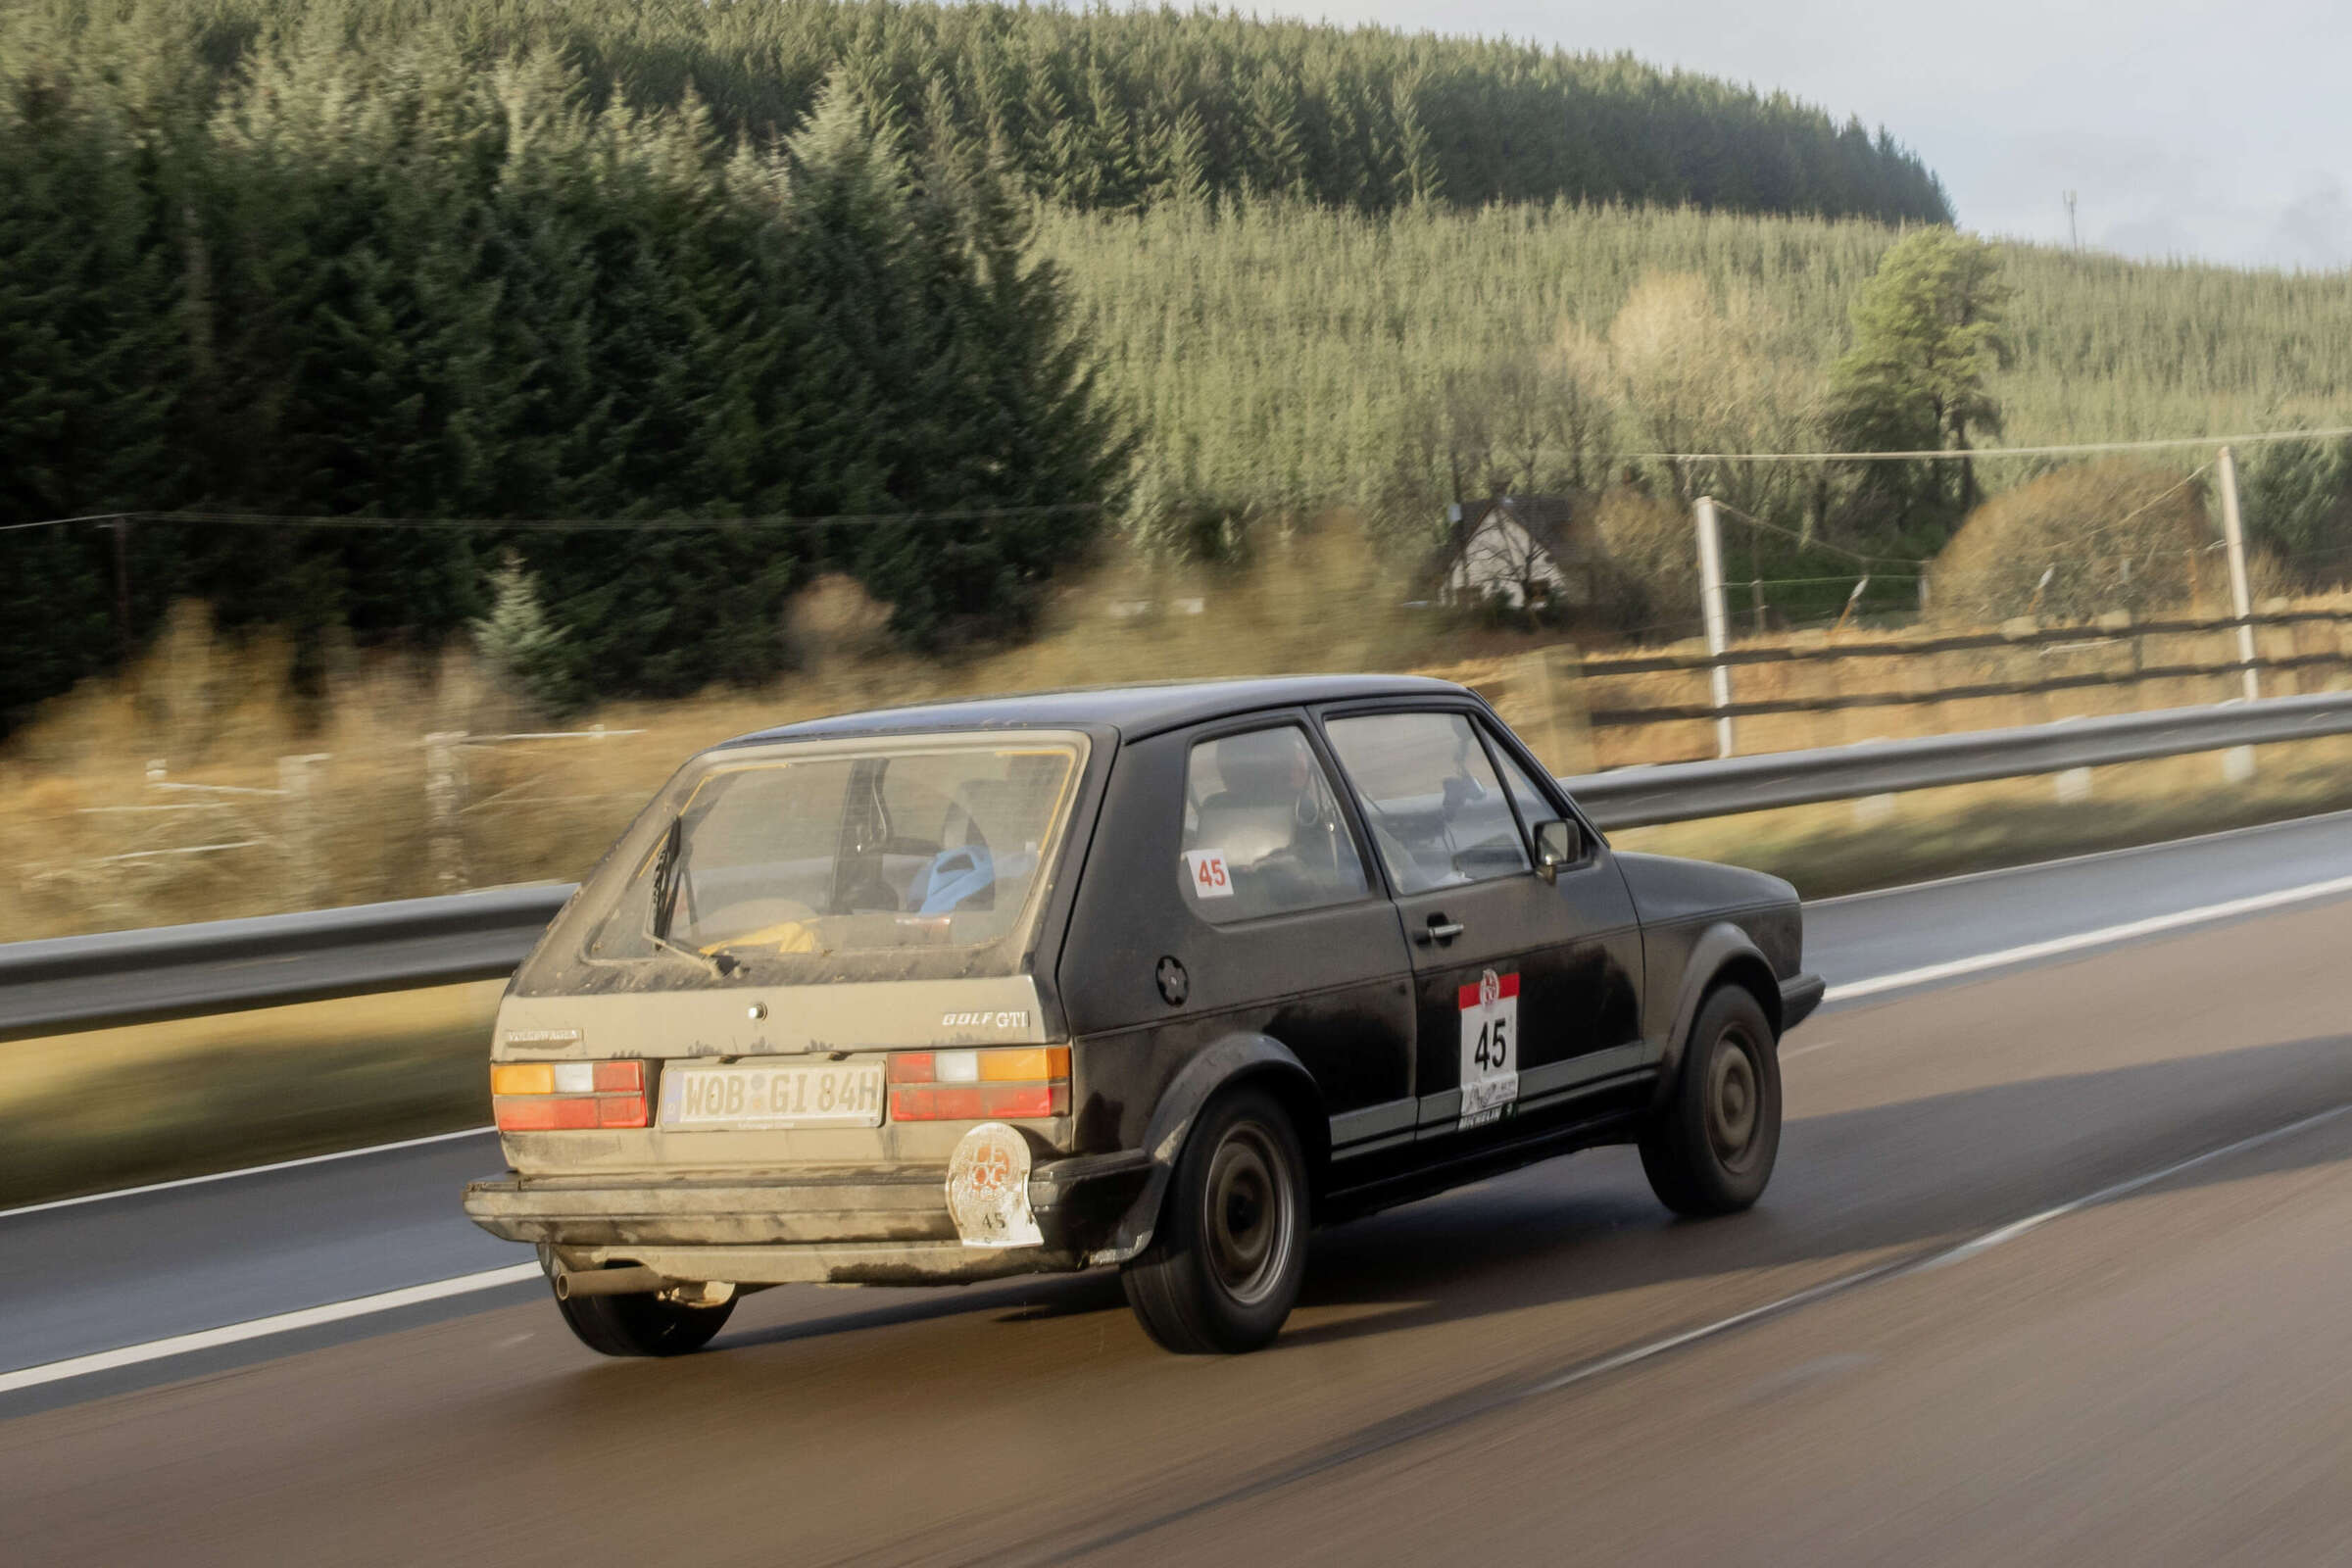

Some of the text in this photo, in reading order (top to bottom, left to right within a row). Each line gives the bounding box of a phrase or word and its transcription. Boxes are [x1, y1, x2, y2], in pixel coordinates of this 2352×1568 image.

[1199, 858, 1226, 887] 45
[942, 1010, 1027, 1028] GOLF GTI
[1474, 1018, 1506, 1071] 45
[685, 1071, 880, 1115] WOB GI 84H
[982, 1212, 1006, 1229] 45
